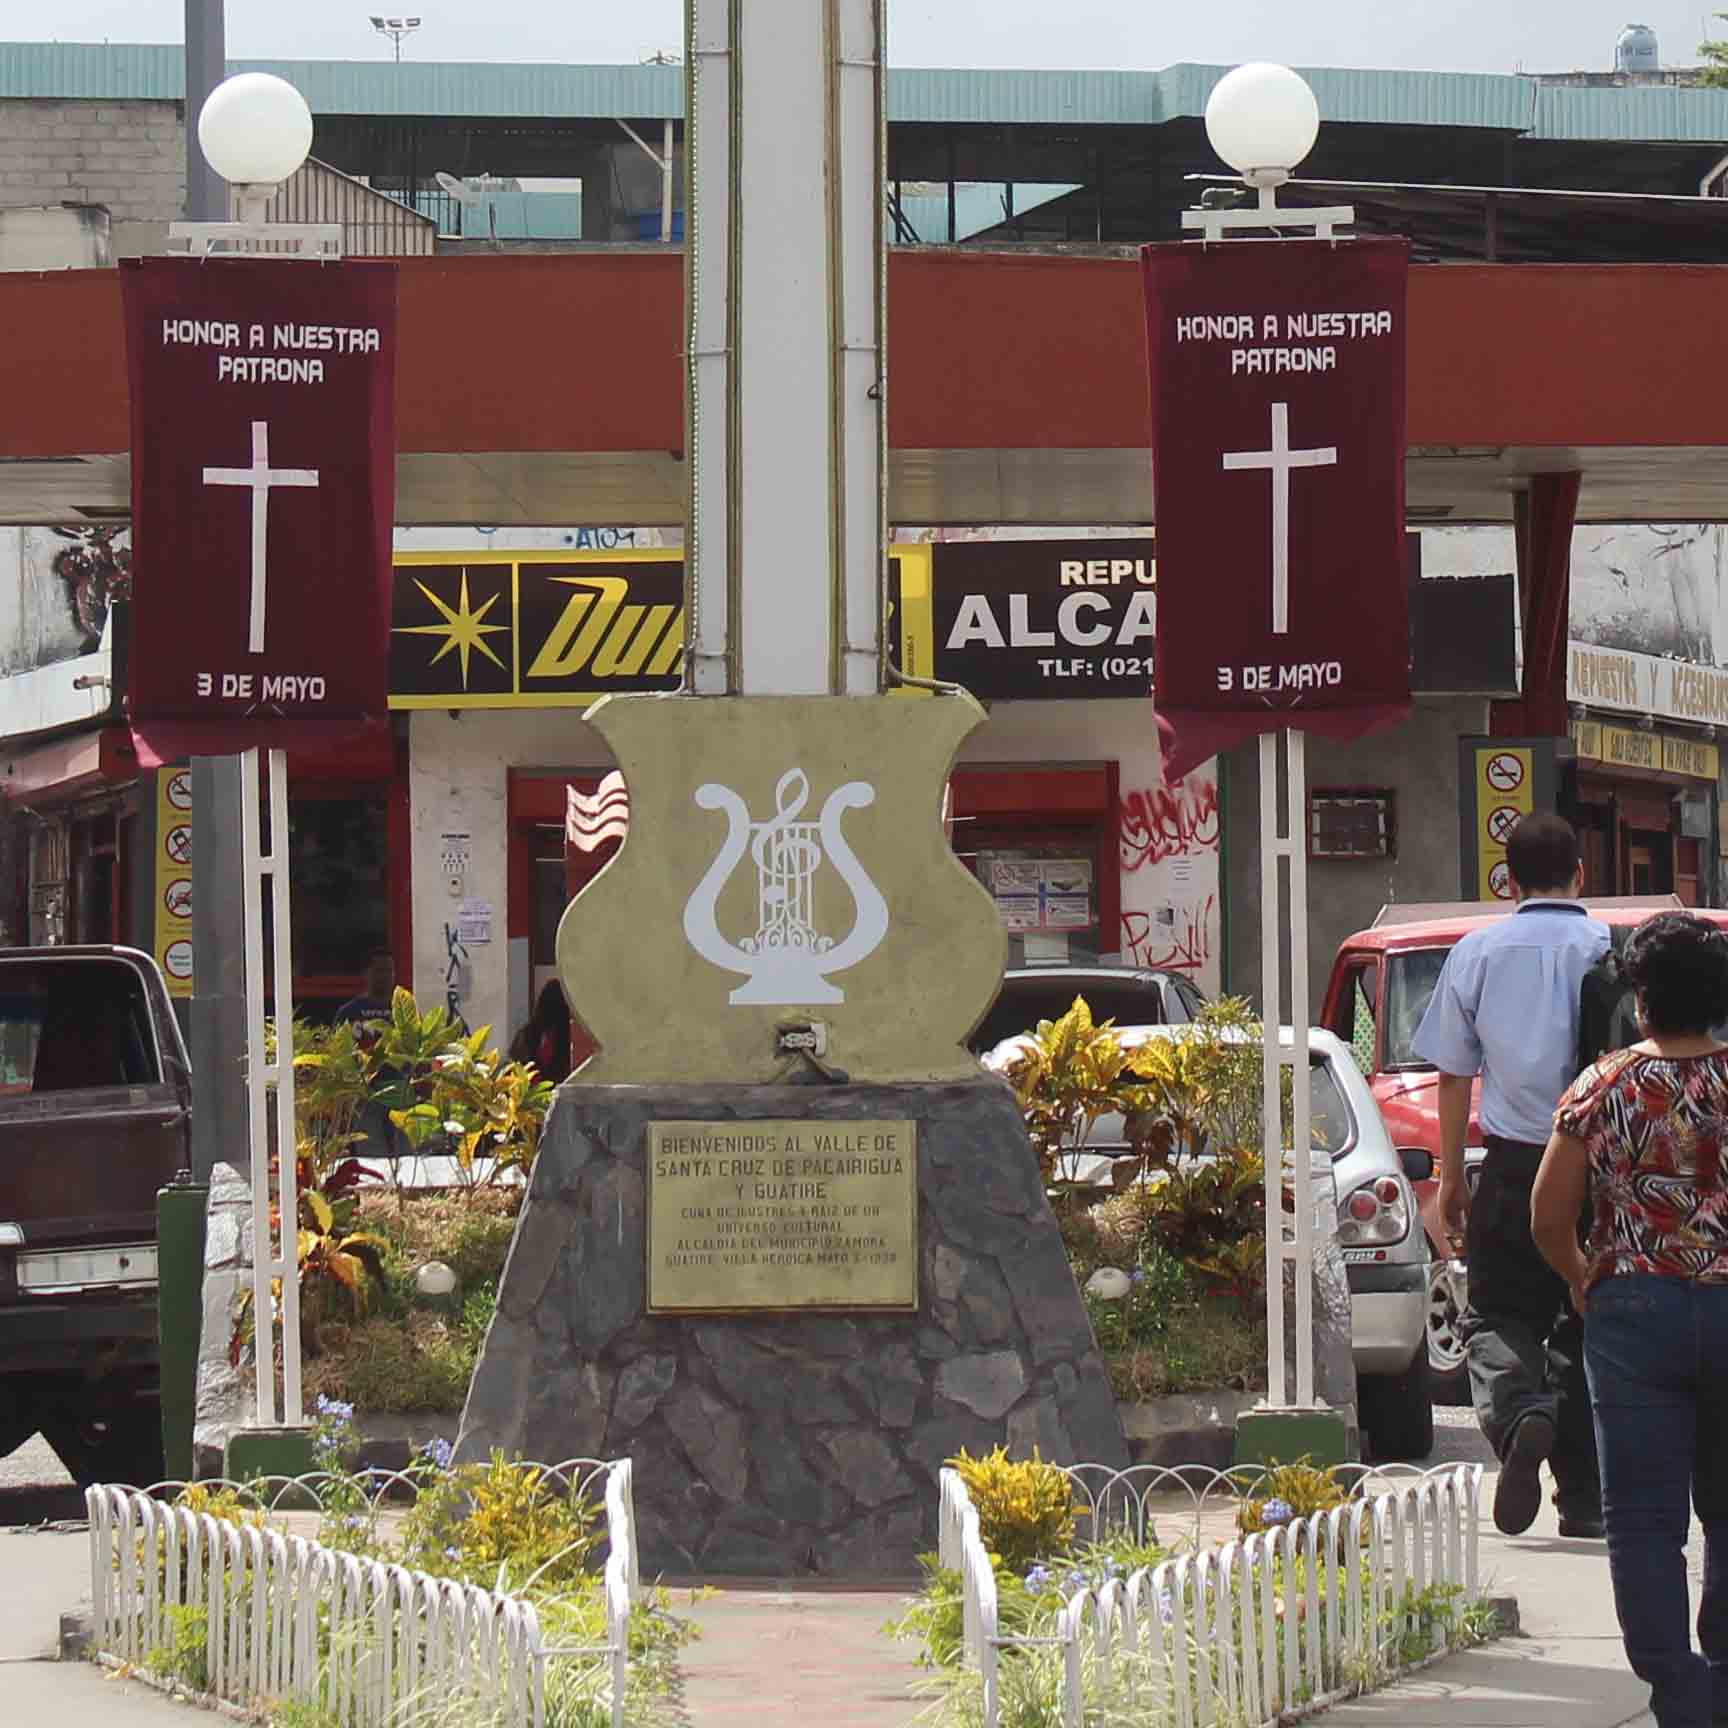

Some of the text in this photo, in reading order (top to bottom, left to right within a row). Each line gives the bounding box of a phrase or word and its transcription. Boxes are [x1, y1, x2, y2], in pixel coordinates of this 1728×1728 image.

[163, 319, 381, 353] HONOR A NUESTRA
[1177, 311, 1392, 342] HONOR A NUESTRA
[218, 355, 323, 384] PATRONA
[1232, 346, 1337, 375] PATRONA
[1060, 559, 1157, 586] REPU
[945, 591, 1157, 649] ALCA
[1038, 658, 1093, 677] TLF:
[1217, 661, 1342, 691] 3 DE MAYO
[197, 672, 326, 702] 3 DE MAYO
[661, 1134, 896, 1155] BIENVENIDOS AL VALLE DE
[655, 1159, 713, 1177] SANTA
[719, 1159, 765, 1177] CRUZ
[773, 1159, 795, 1177] DE
[735, 1183, 744, 1201] Y
